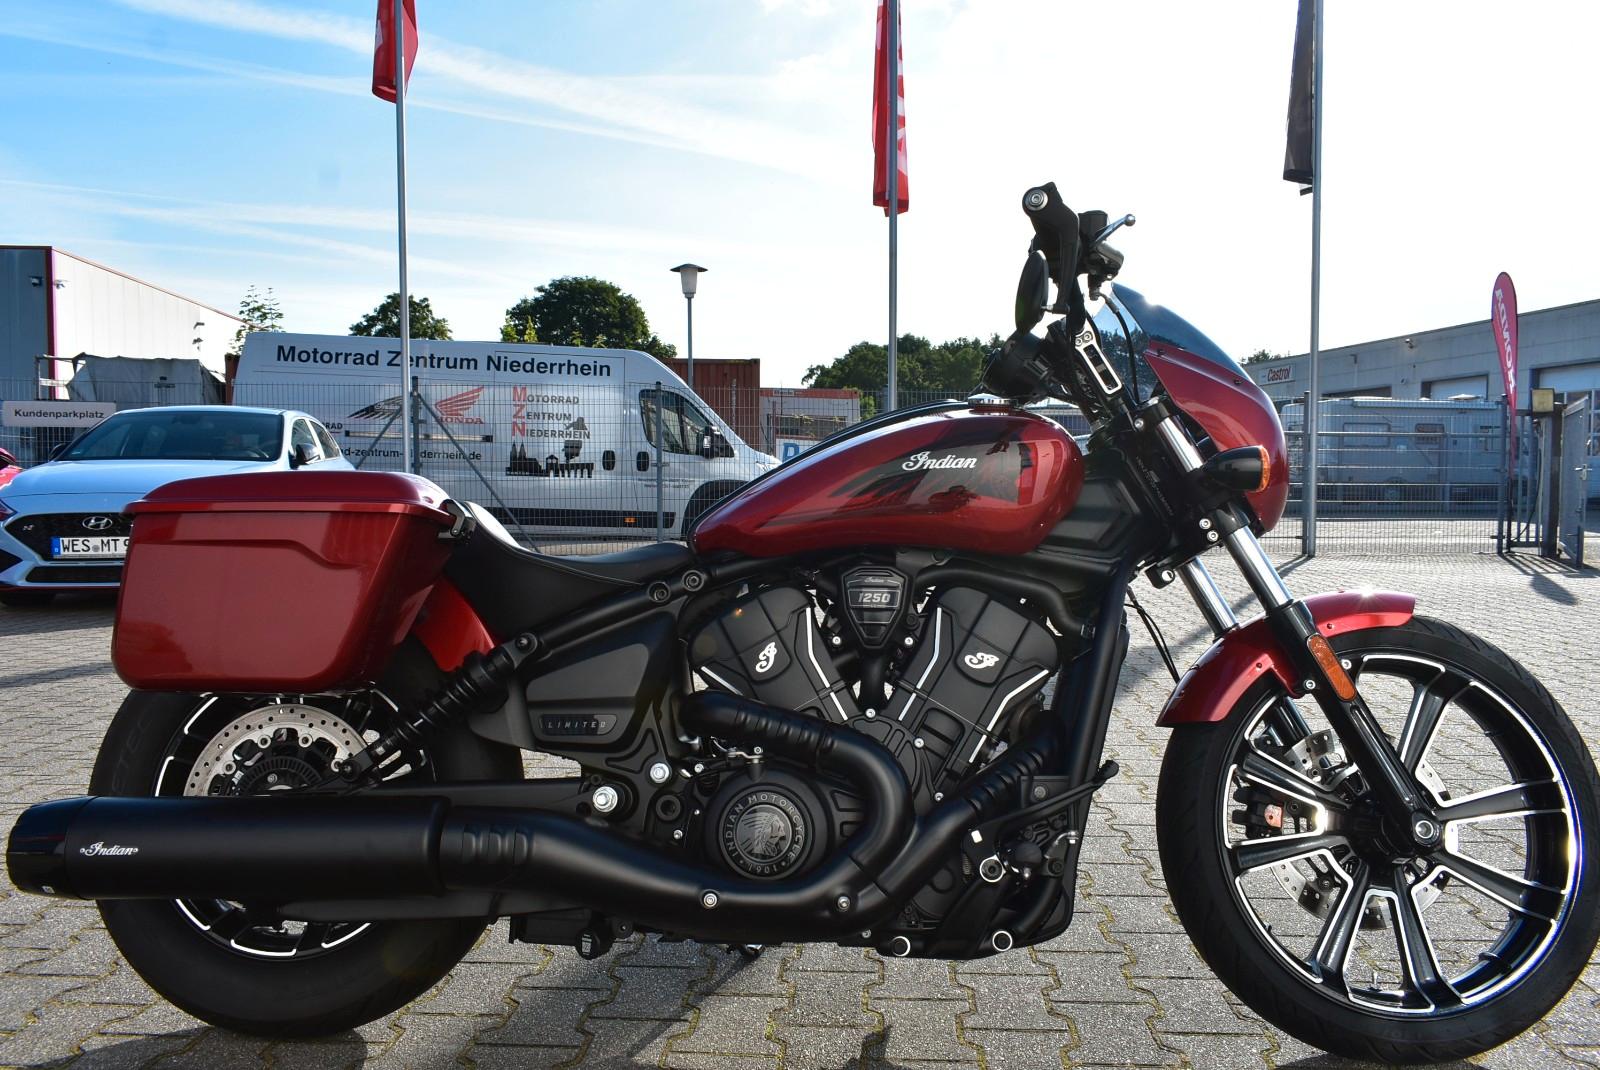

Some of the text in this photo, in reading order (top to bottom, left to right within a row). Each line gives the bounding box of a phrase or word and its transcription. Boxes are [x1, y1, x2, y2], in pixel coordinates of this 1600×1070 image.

[276, 345, 379, 366] Motorrad
[486, 355, 611, 377] Niederrhein
[1267, 364, 1291, 381] Castrol
[512, 385, 580, 404] MOTORRAD
[14, 409, 105, 419] Kundenparkplatz
[512, 403, 572, 421] ZENTRUM
[511, 421, 591, 440] NIEDERRHEIN
[901, 451, 978, 471] Indian
[61, 538, 91, 553] WES
[100, 538, 121, 552] MT
[858, 592, 891, 603] 1250
[547, 721, 606, 729] LIMITED
[725, 793, 805, 864] INDIAN MOTORCYCLE
[84, 841, 134, 857] Indian
[747, 863, 778, 874] 1901
